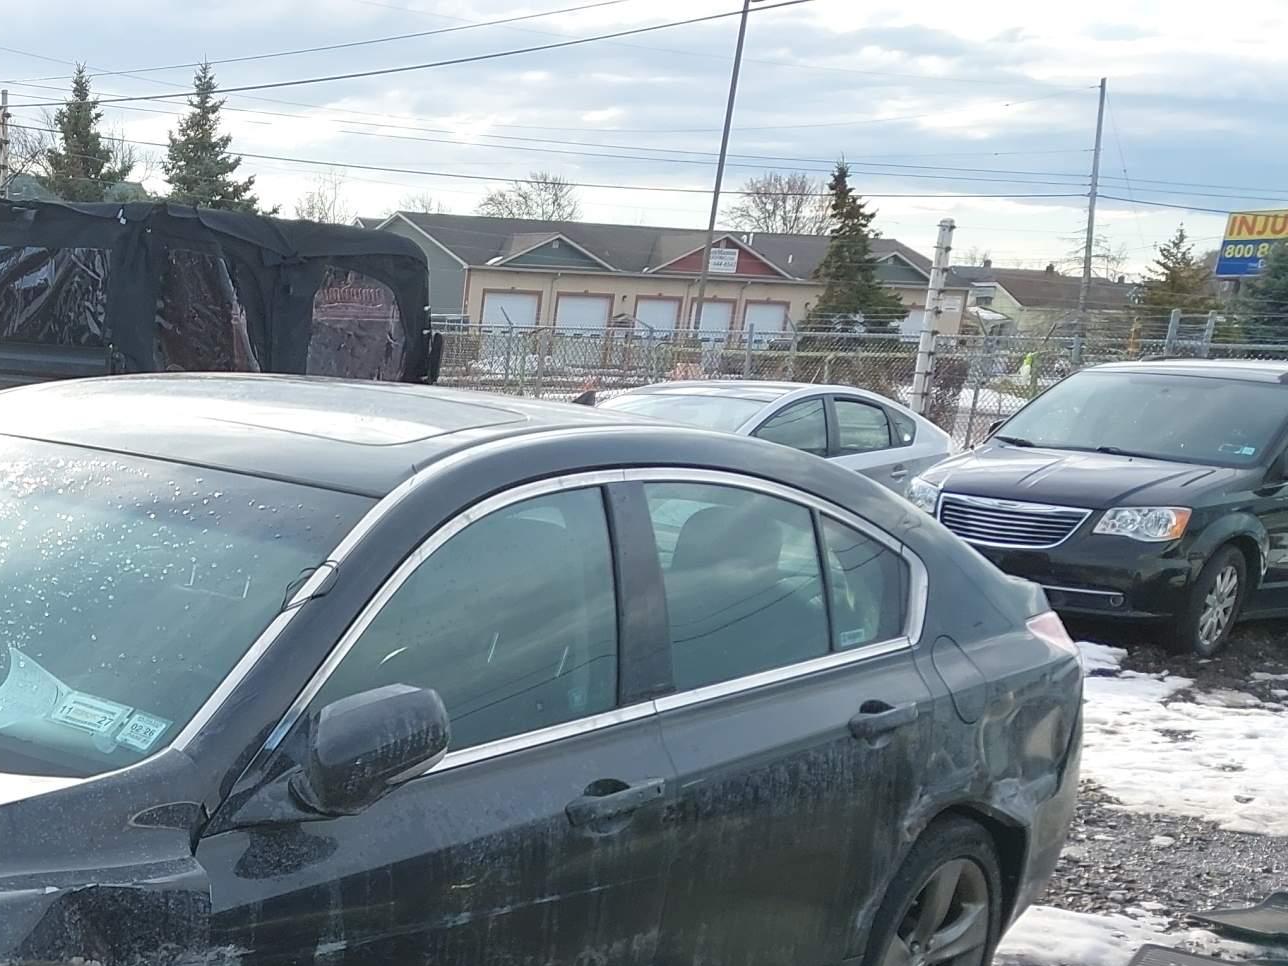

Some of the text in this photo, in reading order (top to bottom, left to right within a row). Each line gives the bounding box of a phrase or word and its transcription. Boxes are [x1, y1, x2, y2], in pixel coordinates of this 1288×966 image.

[1228, 215, 1288, 236] INJU
[1224, 244, 1254, 258] 800
[97, 716, 114, 727] 27
